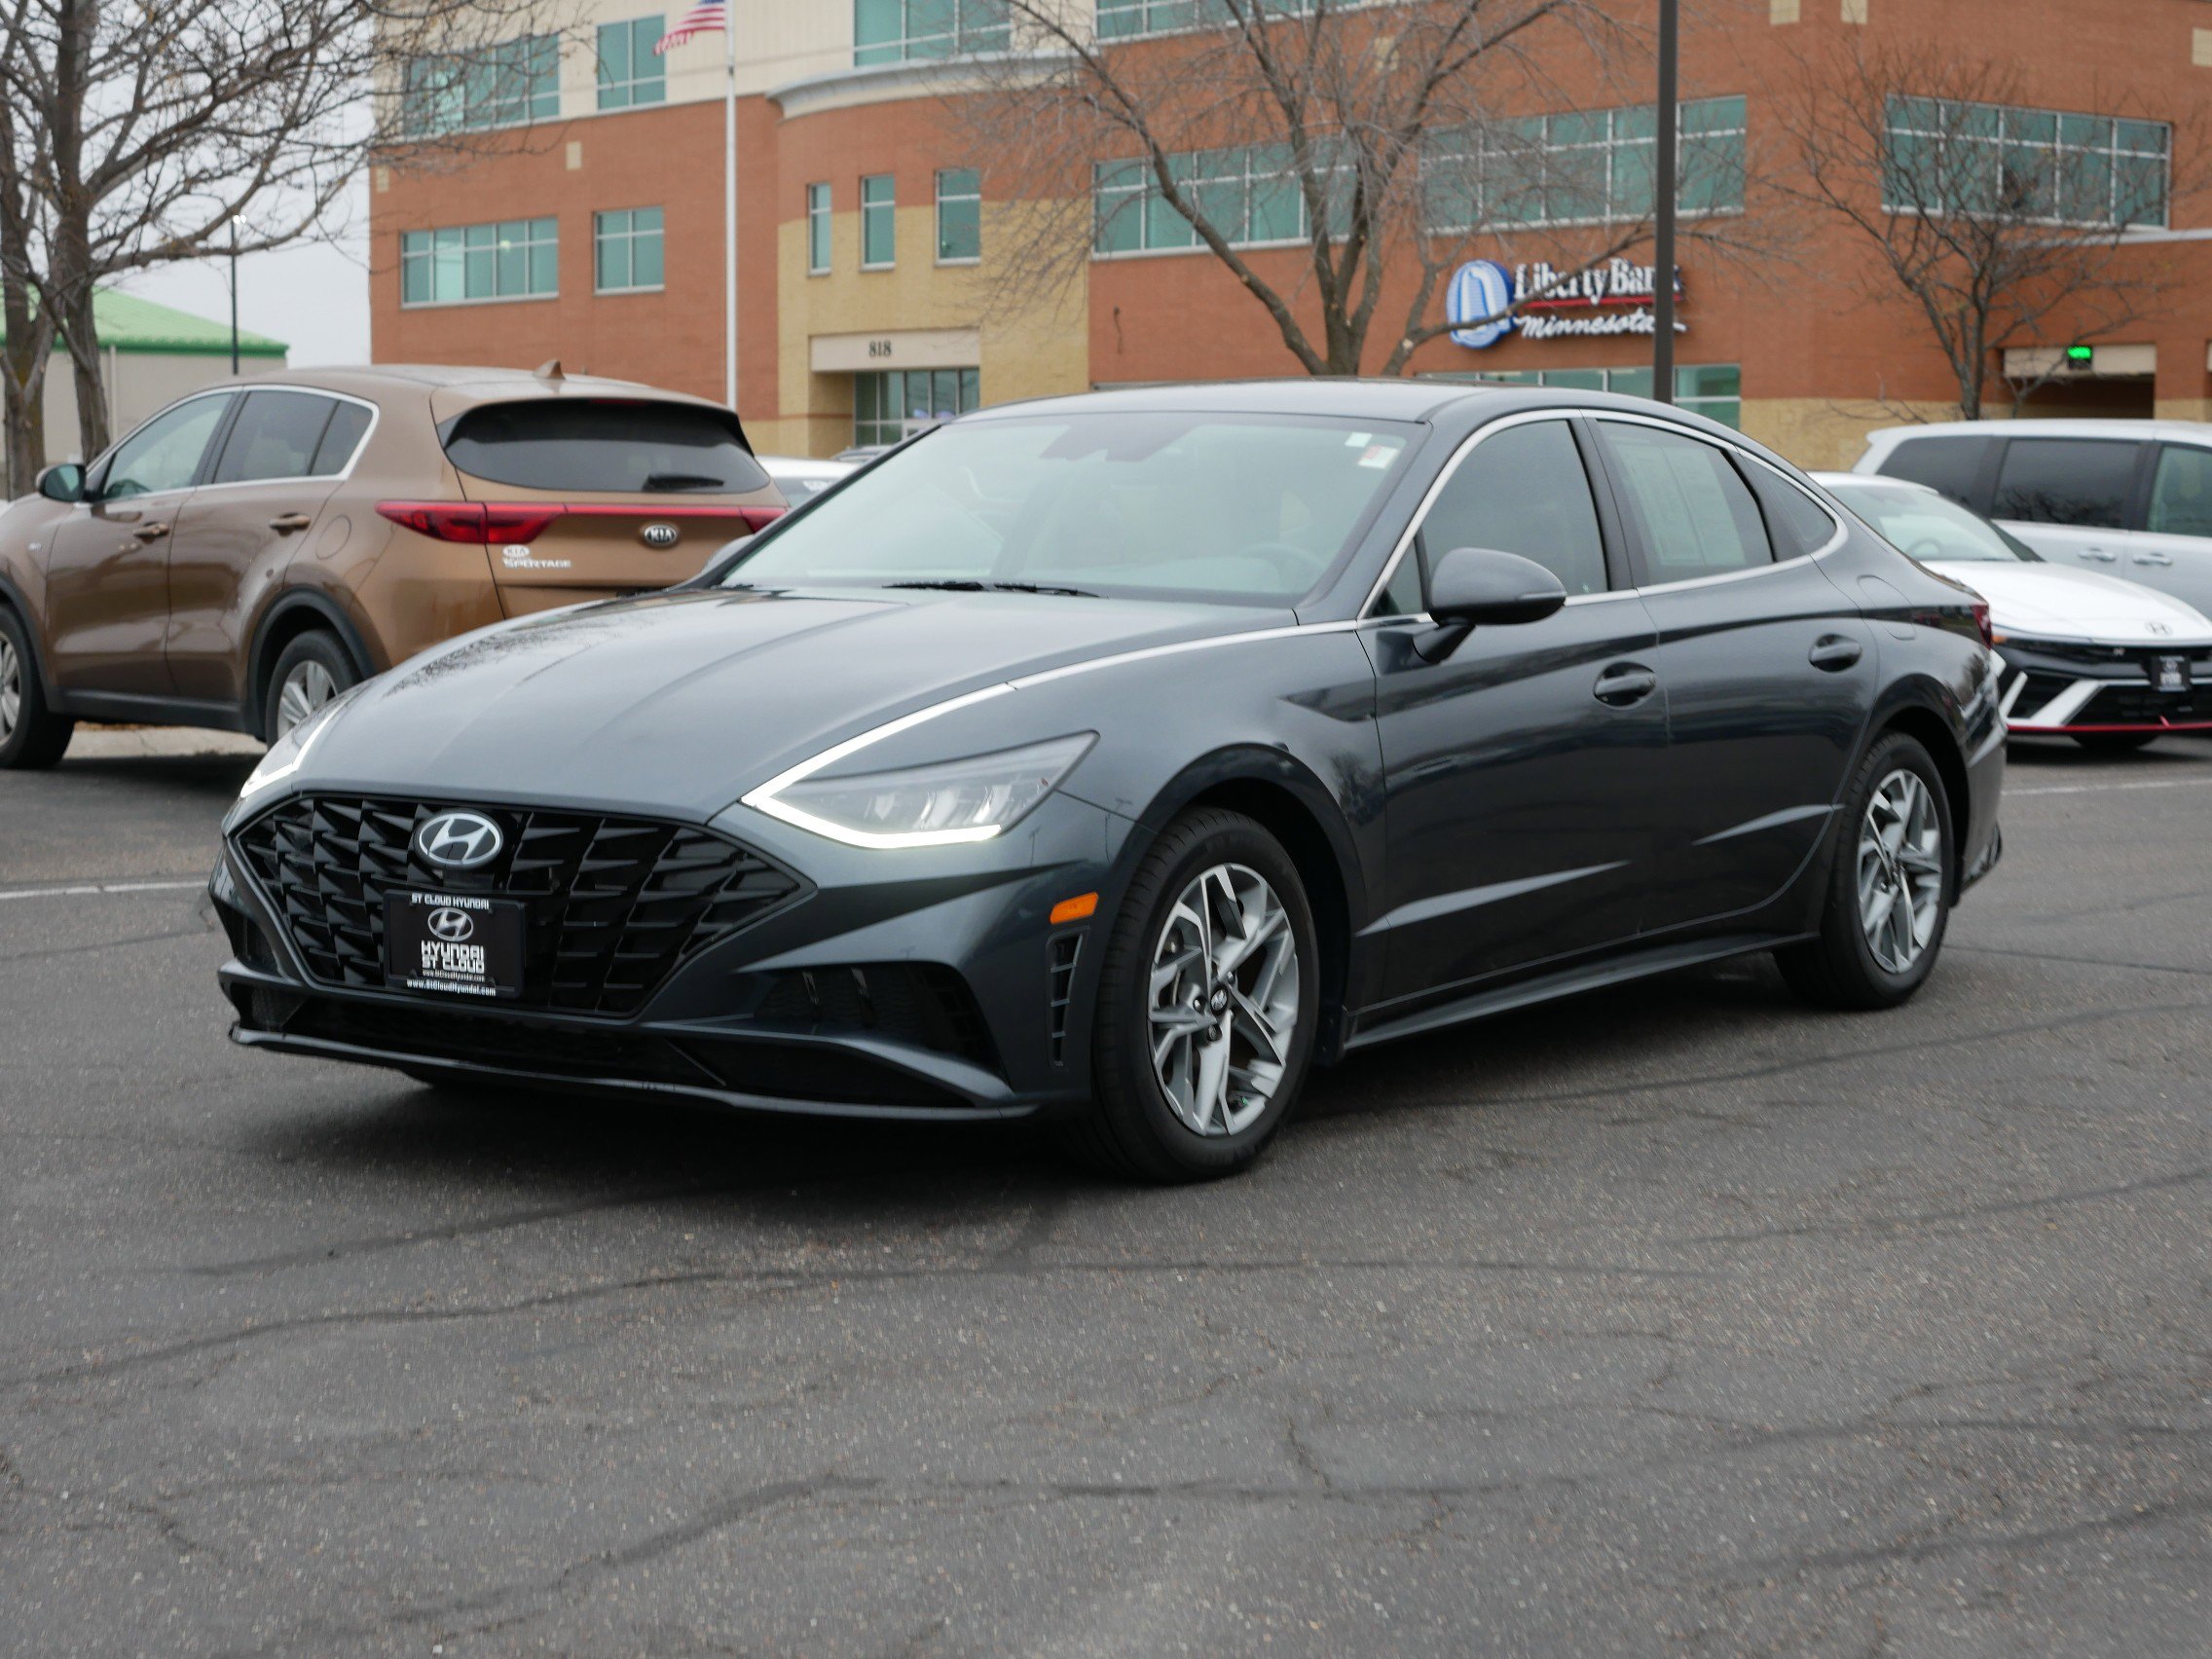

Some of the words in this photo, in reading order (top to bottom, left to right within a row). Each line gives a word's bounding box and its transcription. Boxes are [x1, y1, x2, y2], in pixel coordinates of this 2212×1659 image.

[868, 341, 892, 357] 818
[650, 529, 673, 542] KIA
[411, 892, 423, 903] ST
[424, 894, 452, 906] CLOUD
[453, 897, 490, 909] HYUNDAI
[422, 940, 485, 961] HYUNDAI
[422, 955, 437, 969] ST
[442, 957, 485, 974] CLOUD
